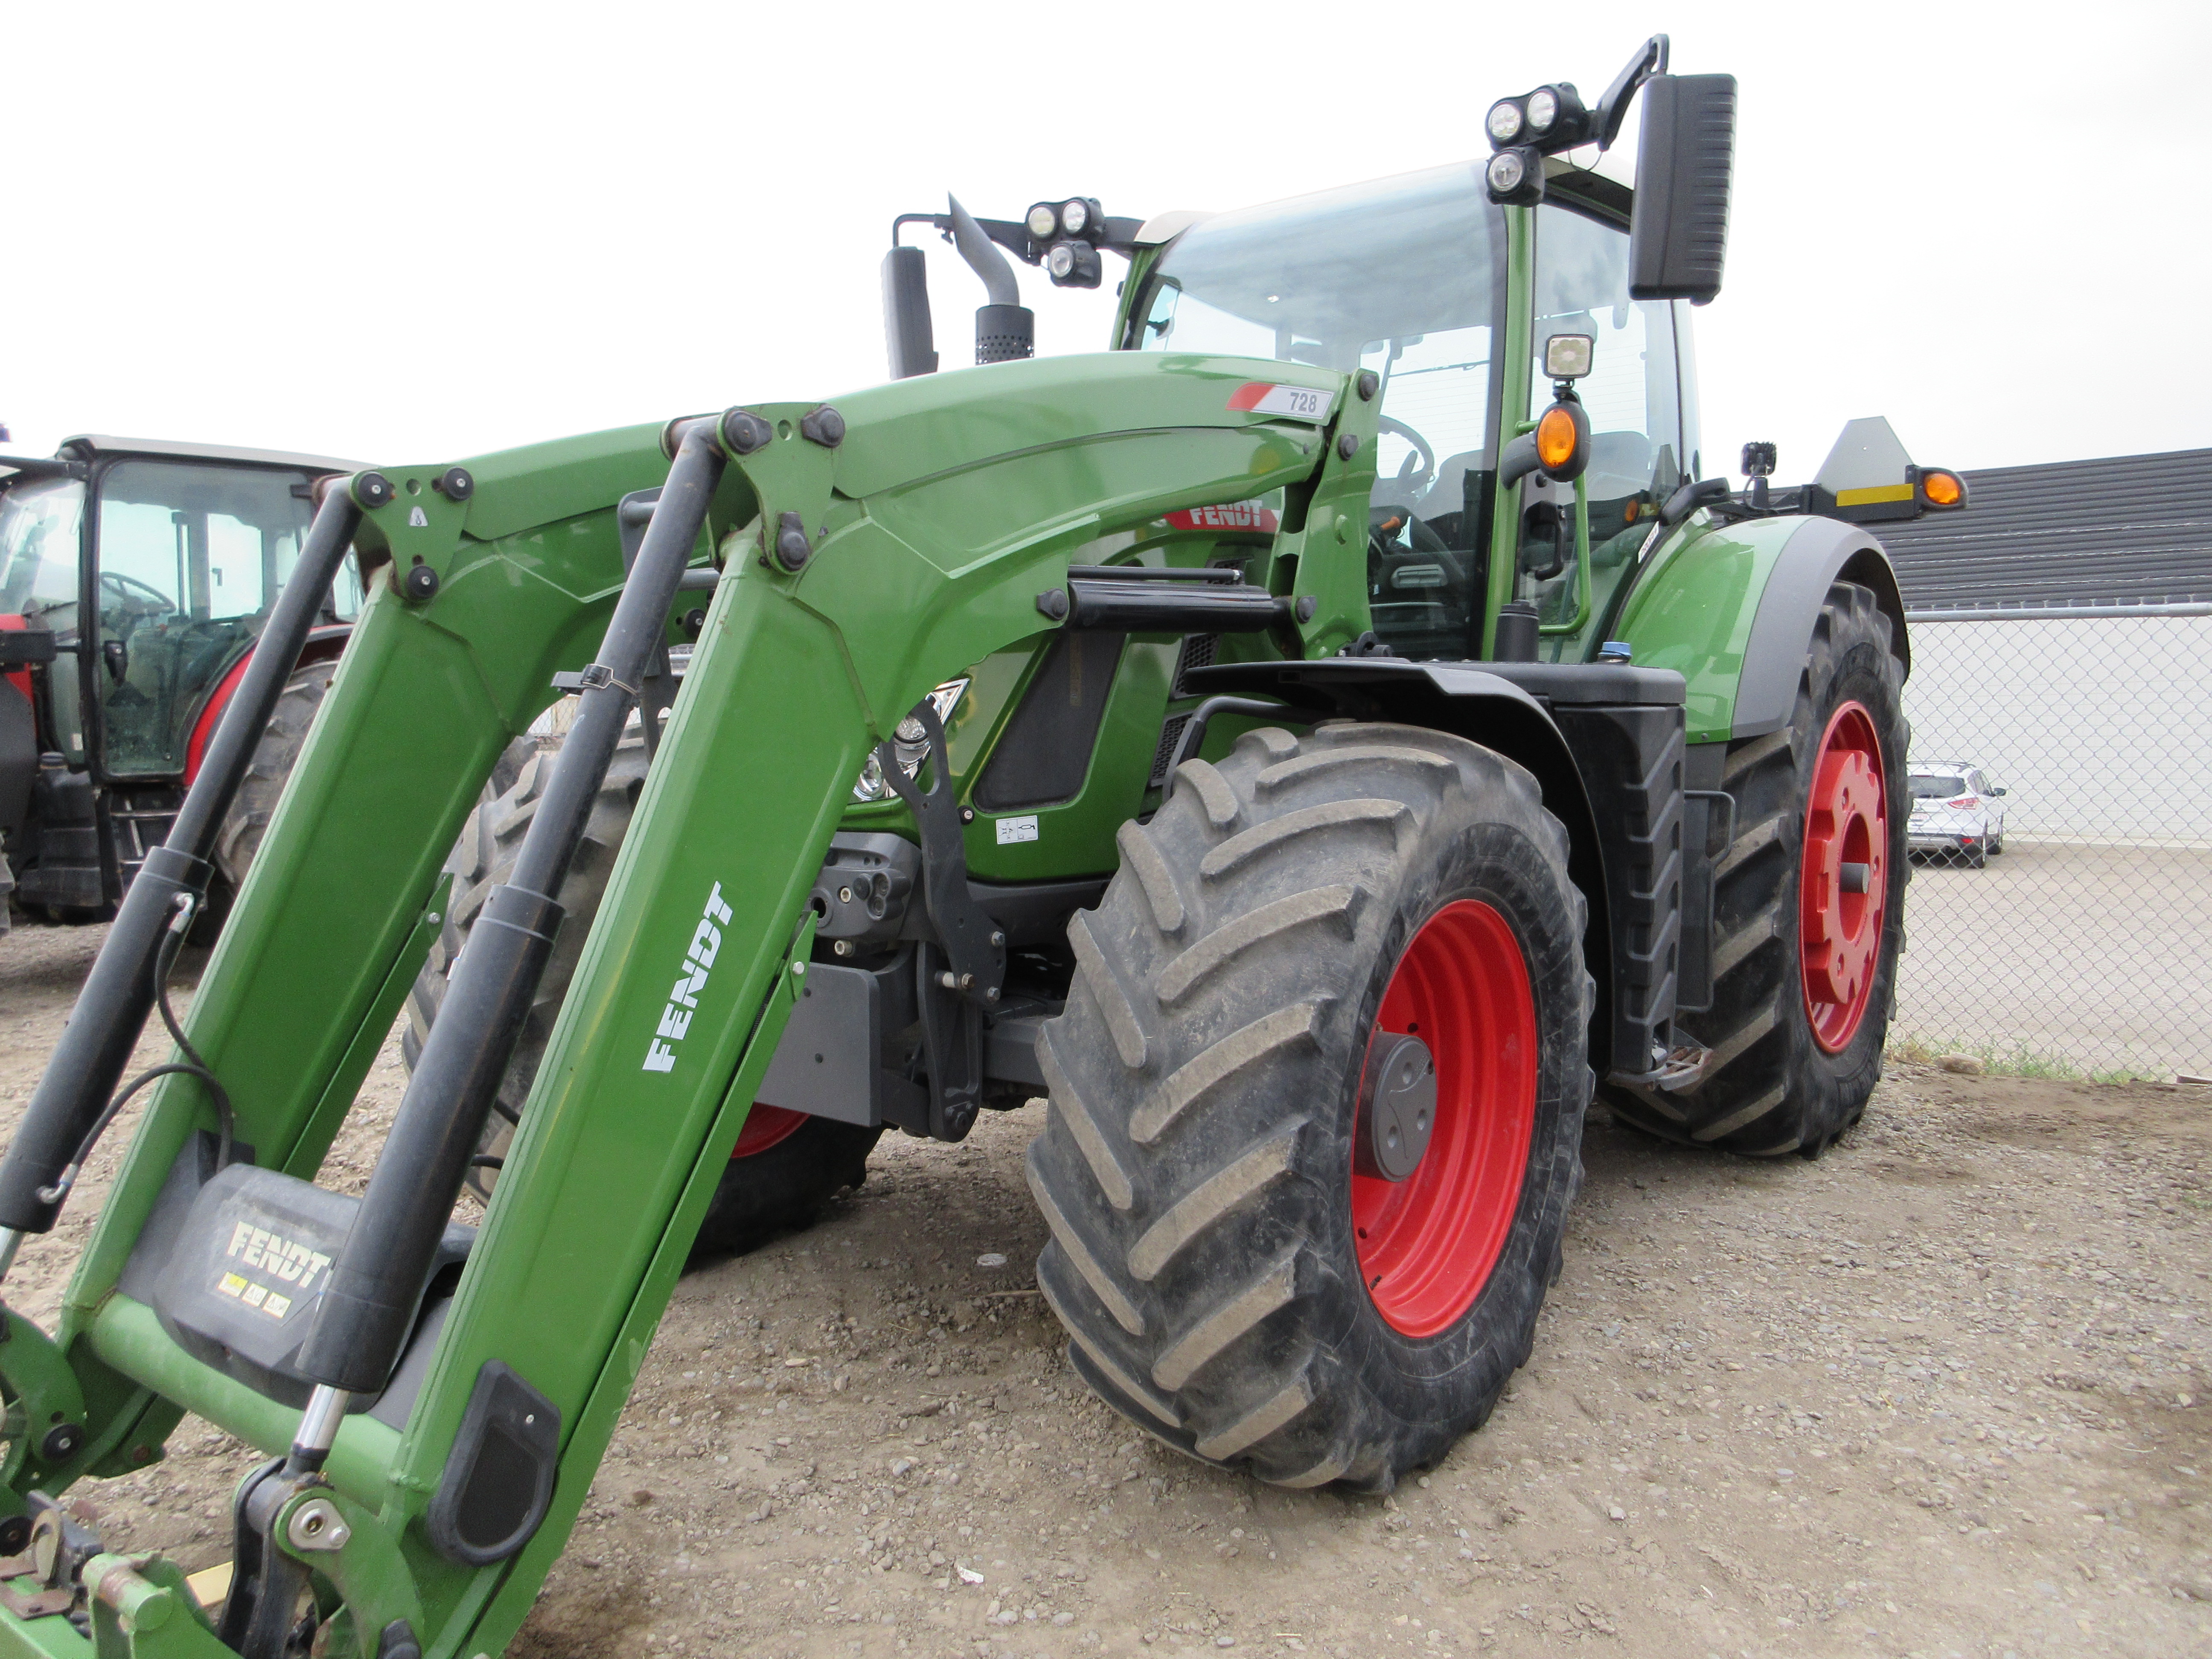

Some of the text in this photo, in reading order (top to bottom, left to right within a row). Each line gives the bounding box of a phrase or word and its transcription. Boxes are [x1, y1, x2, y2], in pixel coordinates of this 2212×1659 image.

[1290, 392, 1318, 413] 728
[1189, 500, 1263, 527] FENDT
[642, 880, 733, 1073] FENDT
[227, 1221, 332, 1288] FENDT
